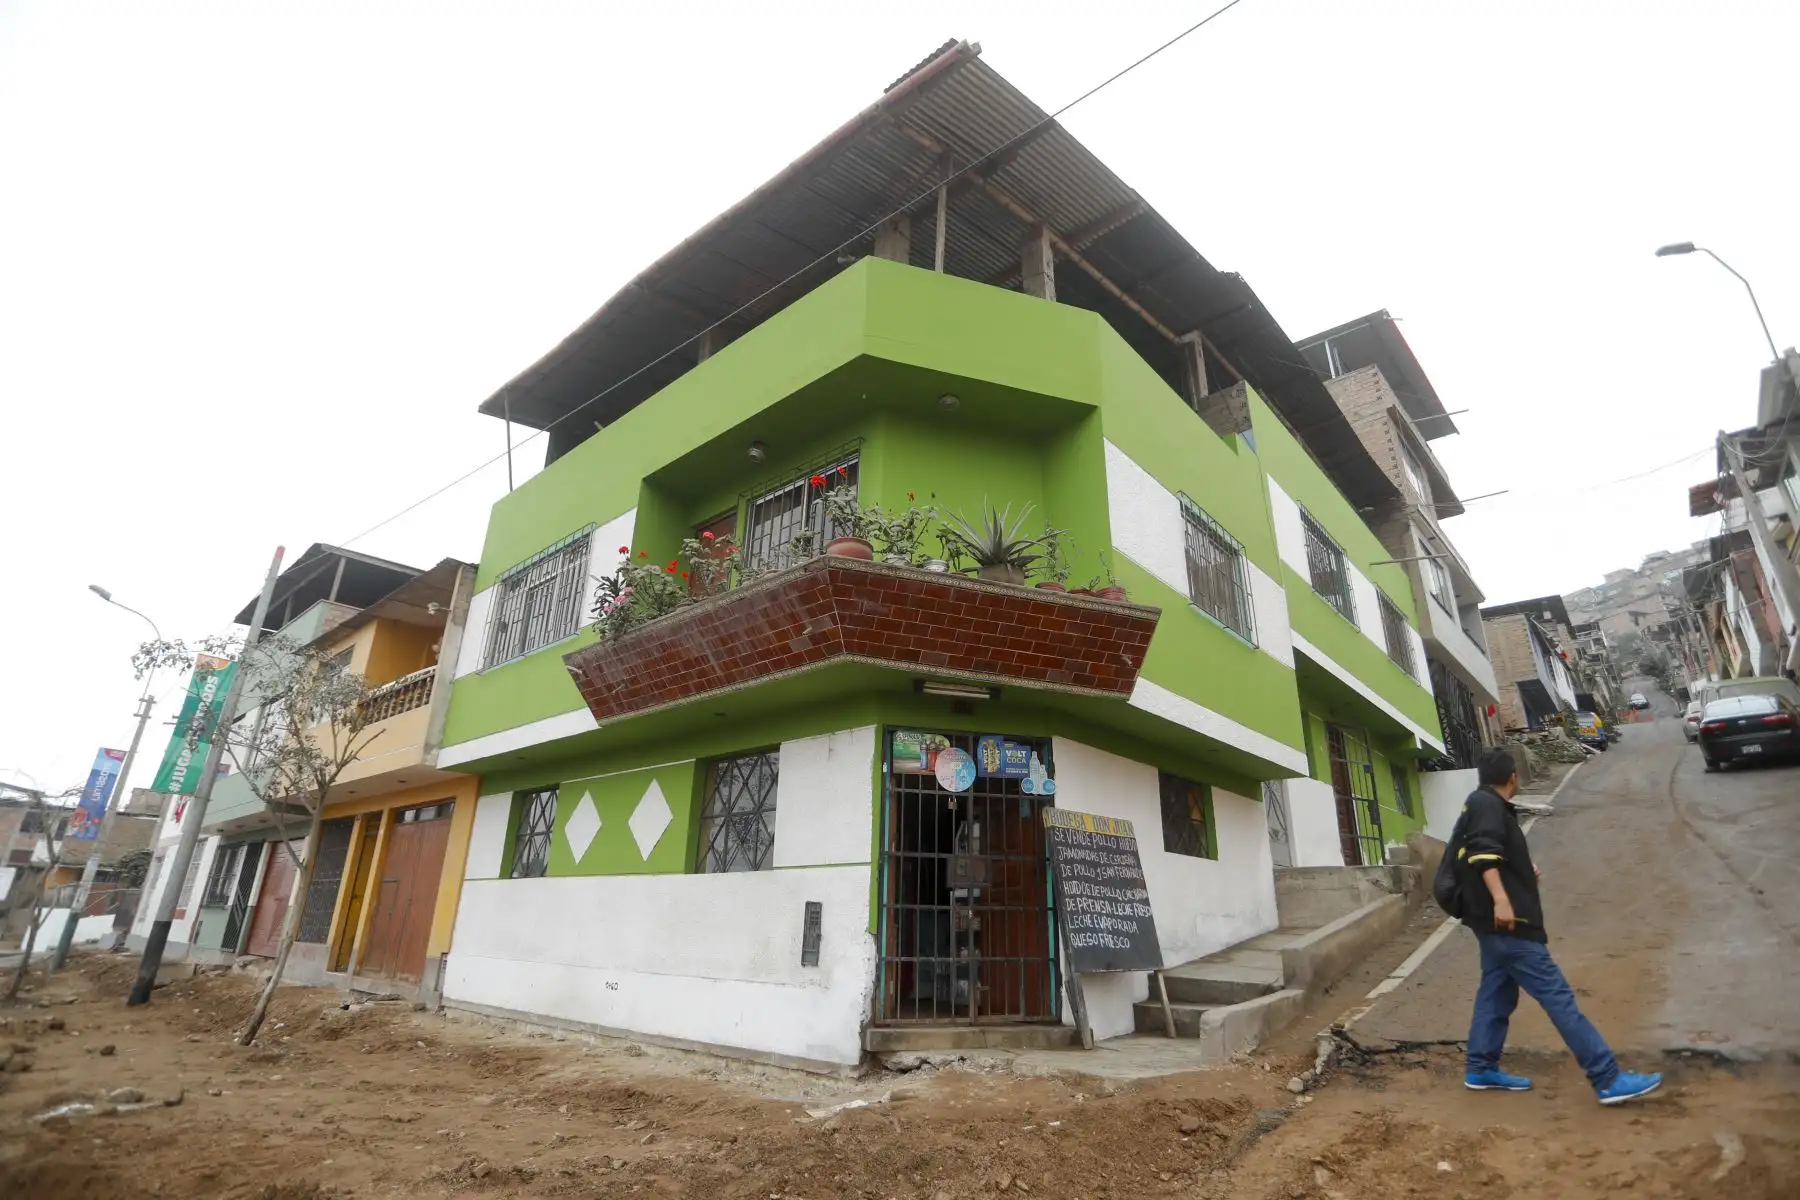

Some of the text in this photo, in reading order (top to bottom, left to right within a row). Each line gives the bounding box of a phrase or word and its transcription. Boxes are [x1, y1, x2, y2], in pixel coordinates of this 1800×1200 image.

[1049, 808, 1134, 836] BODEGA DON JUAN
[1054, 828, 1065, 842] SE
[1065, 829, 1092, 846] VENDE
[1092, 833, 1117, 849] POLLO
[1099, 852, 1109, 863] DE
[1060, 863, 1072, 878] DE
[1073, 863, 1095, 878] POLLO
[1065, 898, 1076, 912] DE
[1067, 914, 1139, 934] LECHE EVAPORADA
[1070, 932, 1130, 949] QUESO FRESCO
